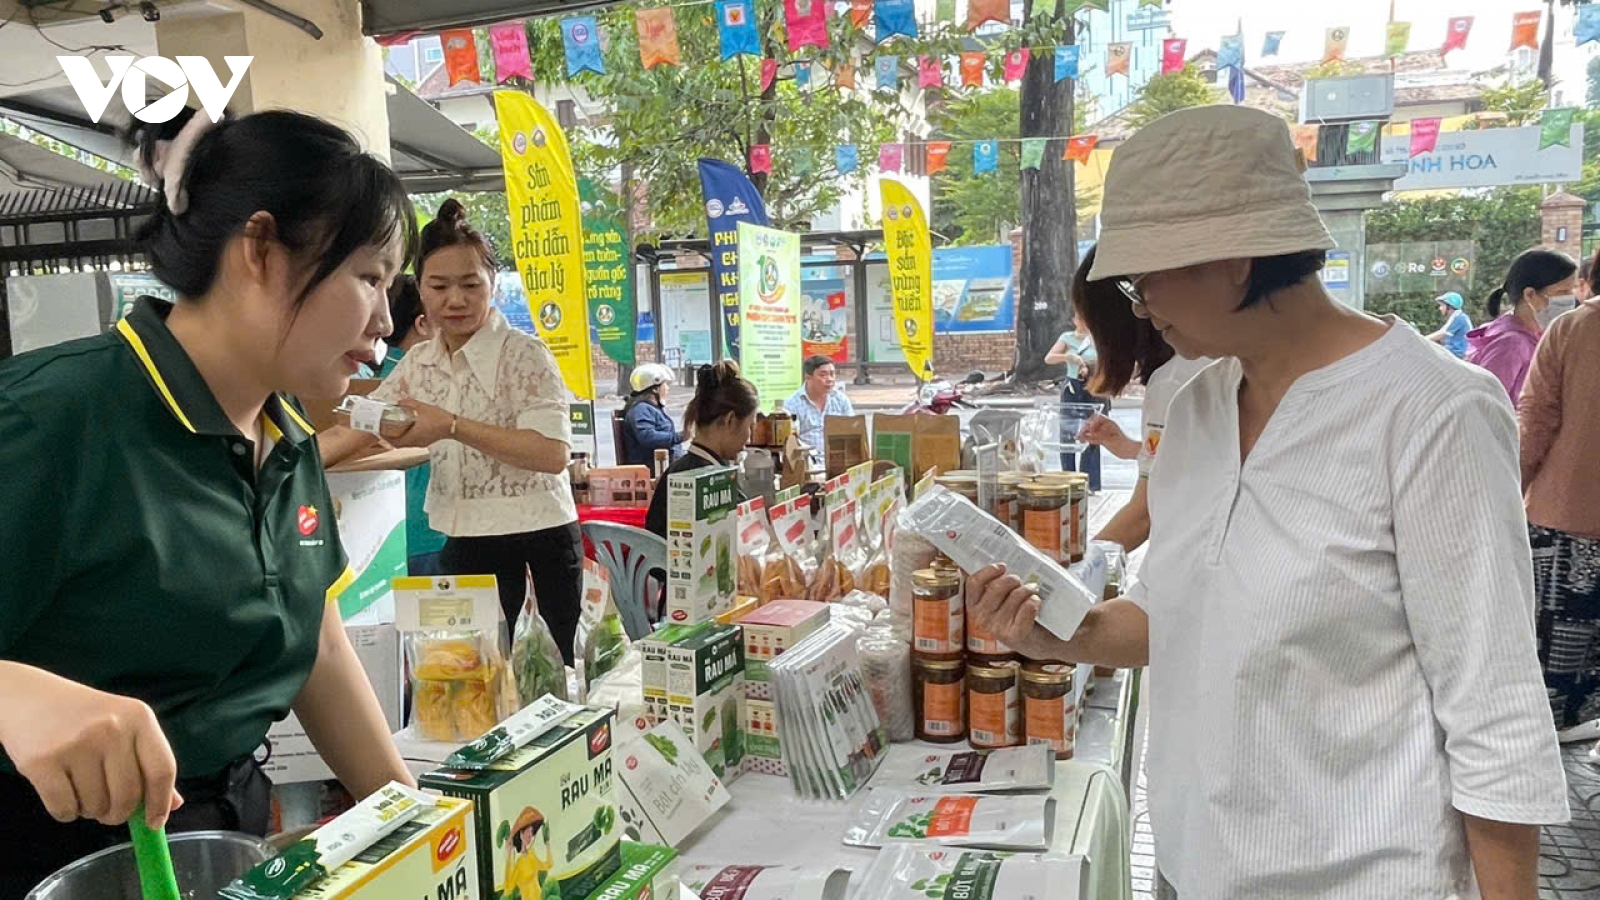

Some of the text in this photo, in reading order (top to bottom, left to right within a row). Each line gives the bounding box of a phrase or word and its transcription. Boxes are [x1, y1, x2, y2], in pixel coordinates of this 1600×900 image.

[528, 163, 551, 189] Sản
[1450, 153, 1497, 171] HOA
[521, 193, 561, 229] phẩm
[543, 228, 570, 256] dẫn
[525, 260, 565, 295] địa lý
[705, 657, 723, 683] RAU
[561, 773, 588, 812] RAU
[593, 749, 612, 789] MÁ
[437, 855, 467, 900] MÁ
